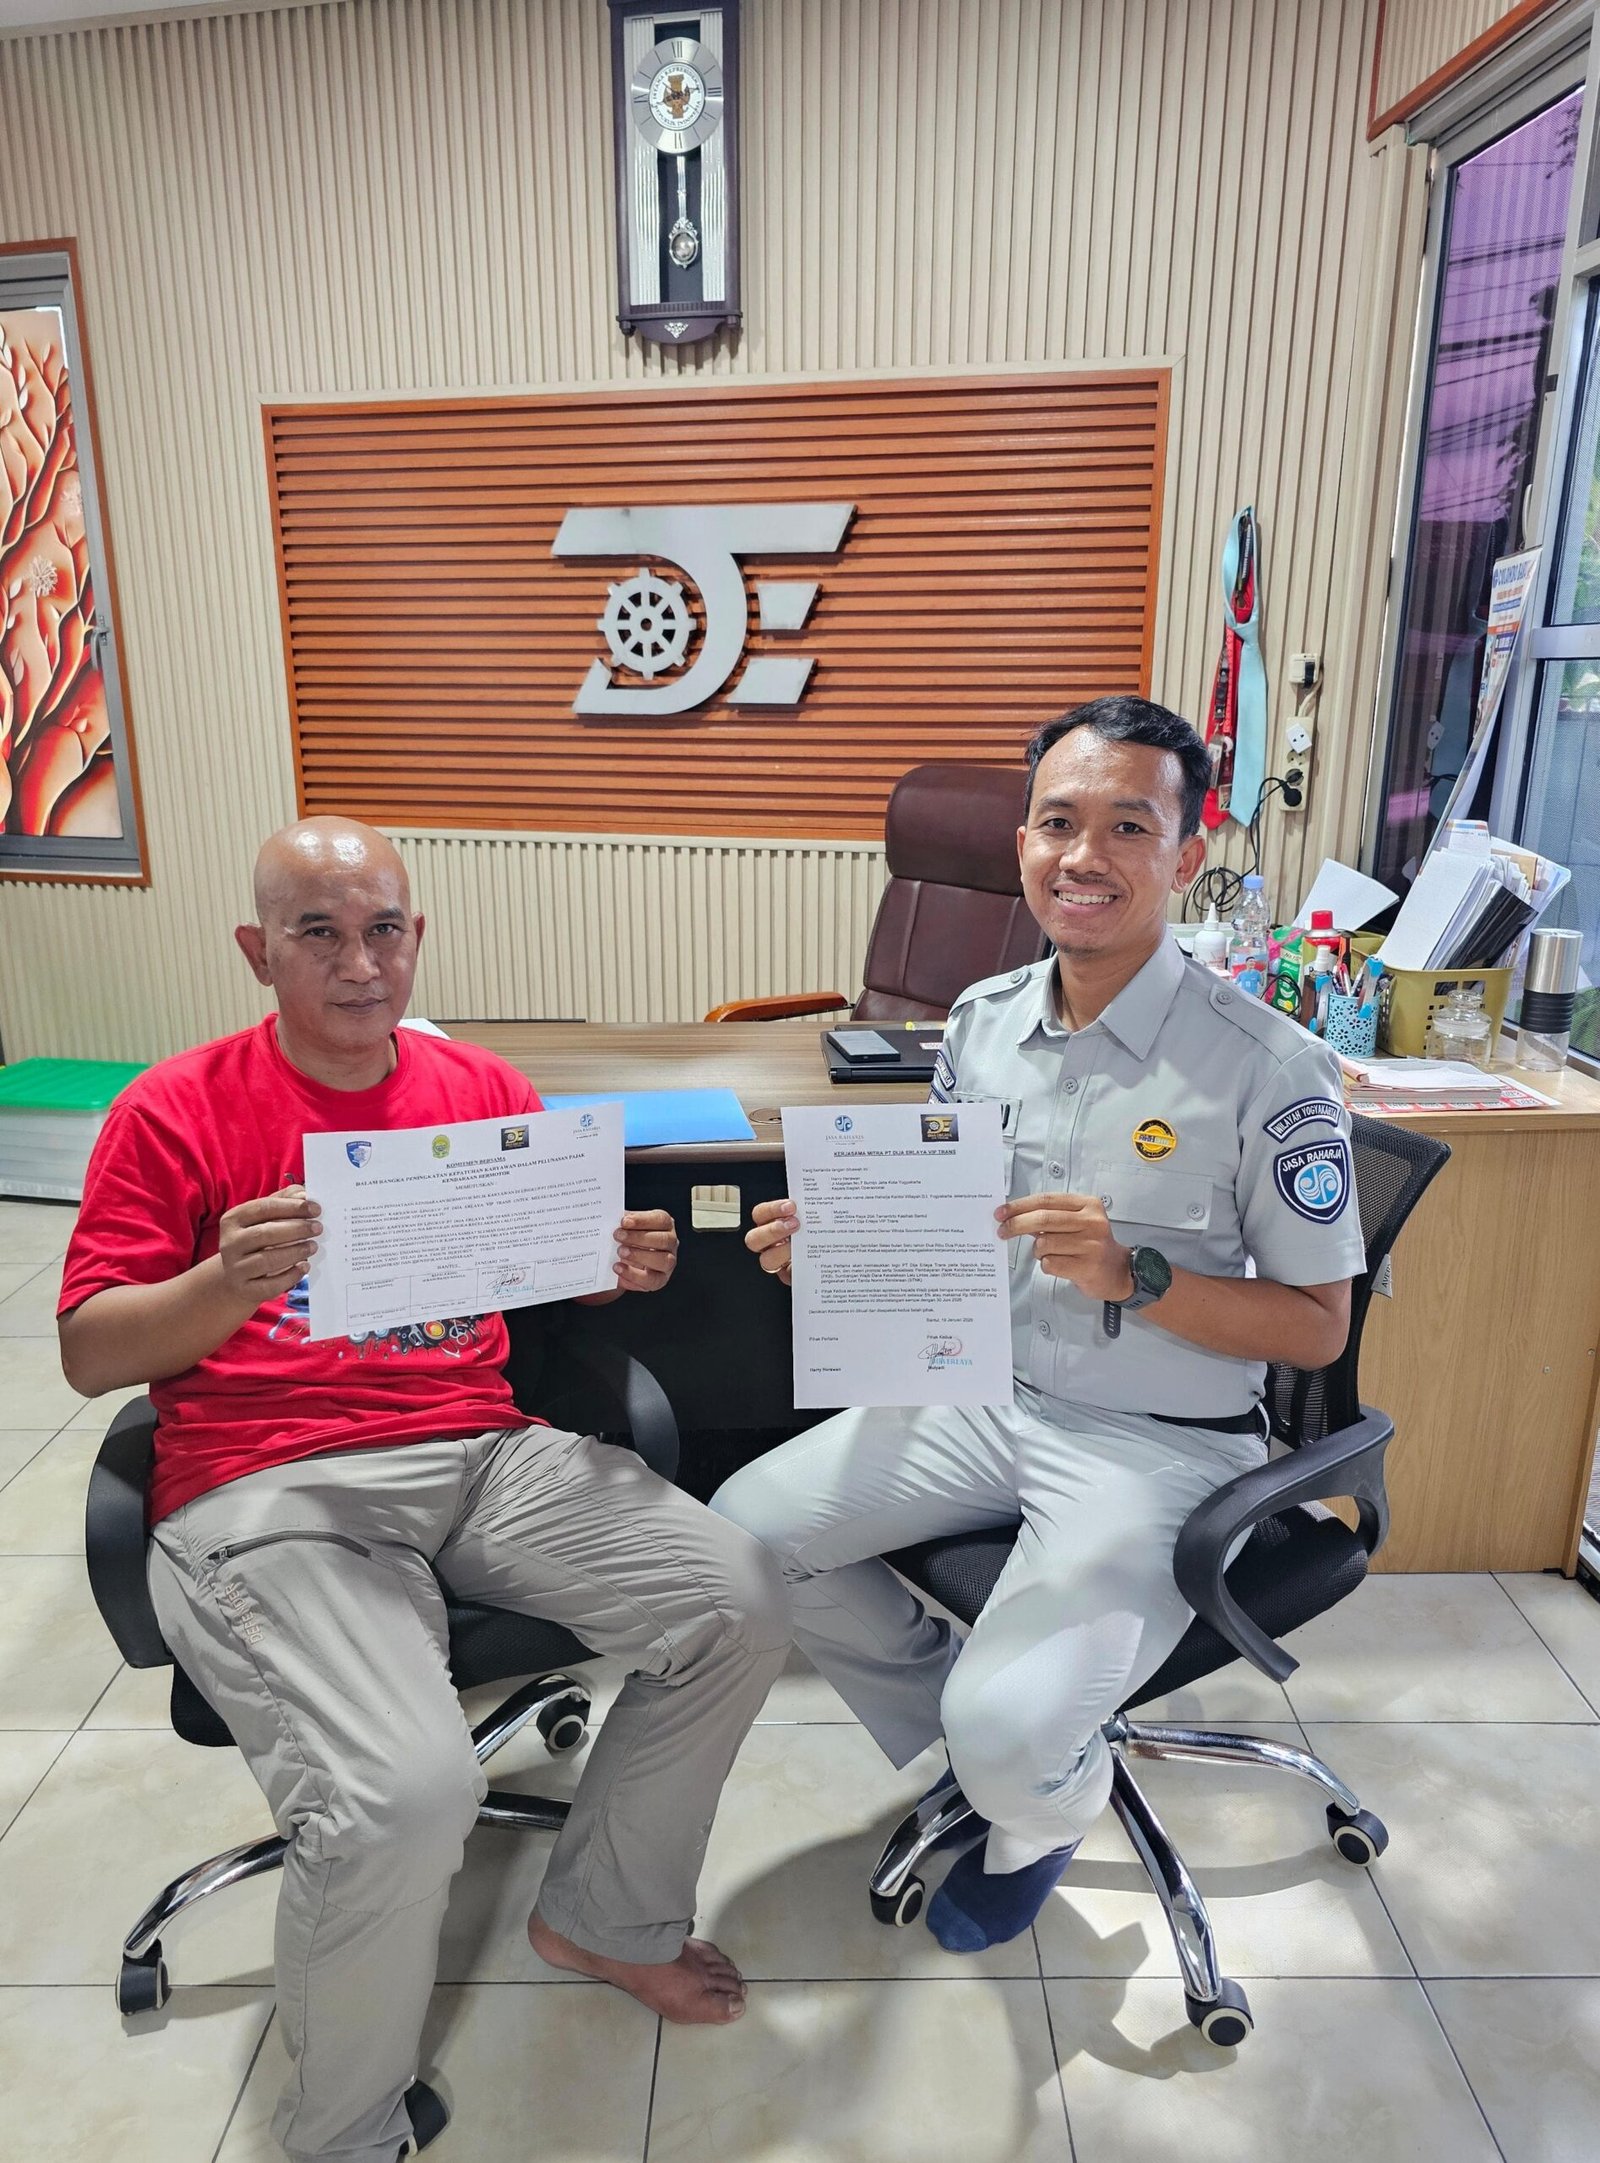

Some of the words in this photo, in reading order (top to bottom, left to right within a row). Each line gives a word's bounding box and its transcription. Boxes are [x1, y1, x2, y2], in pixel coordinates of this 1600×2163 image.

[1274, 1112, 1300, 1134] WILAYAH
[1301, 1104, 1337, 1118] YOGYAKARTA
[1282, 1155, 1306, 1172] JASA
[1306, 1149, 1342, 1162] RAHARJA
[225, 1582, 264, 1646] DEFENDER
